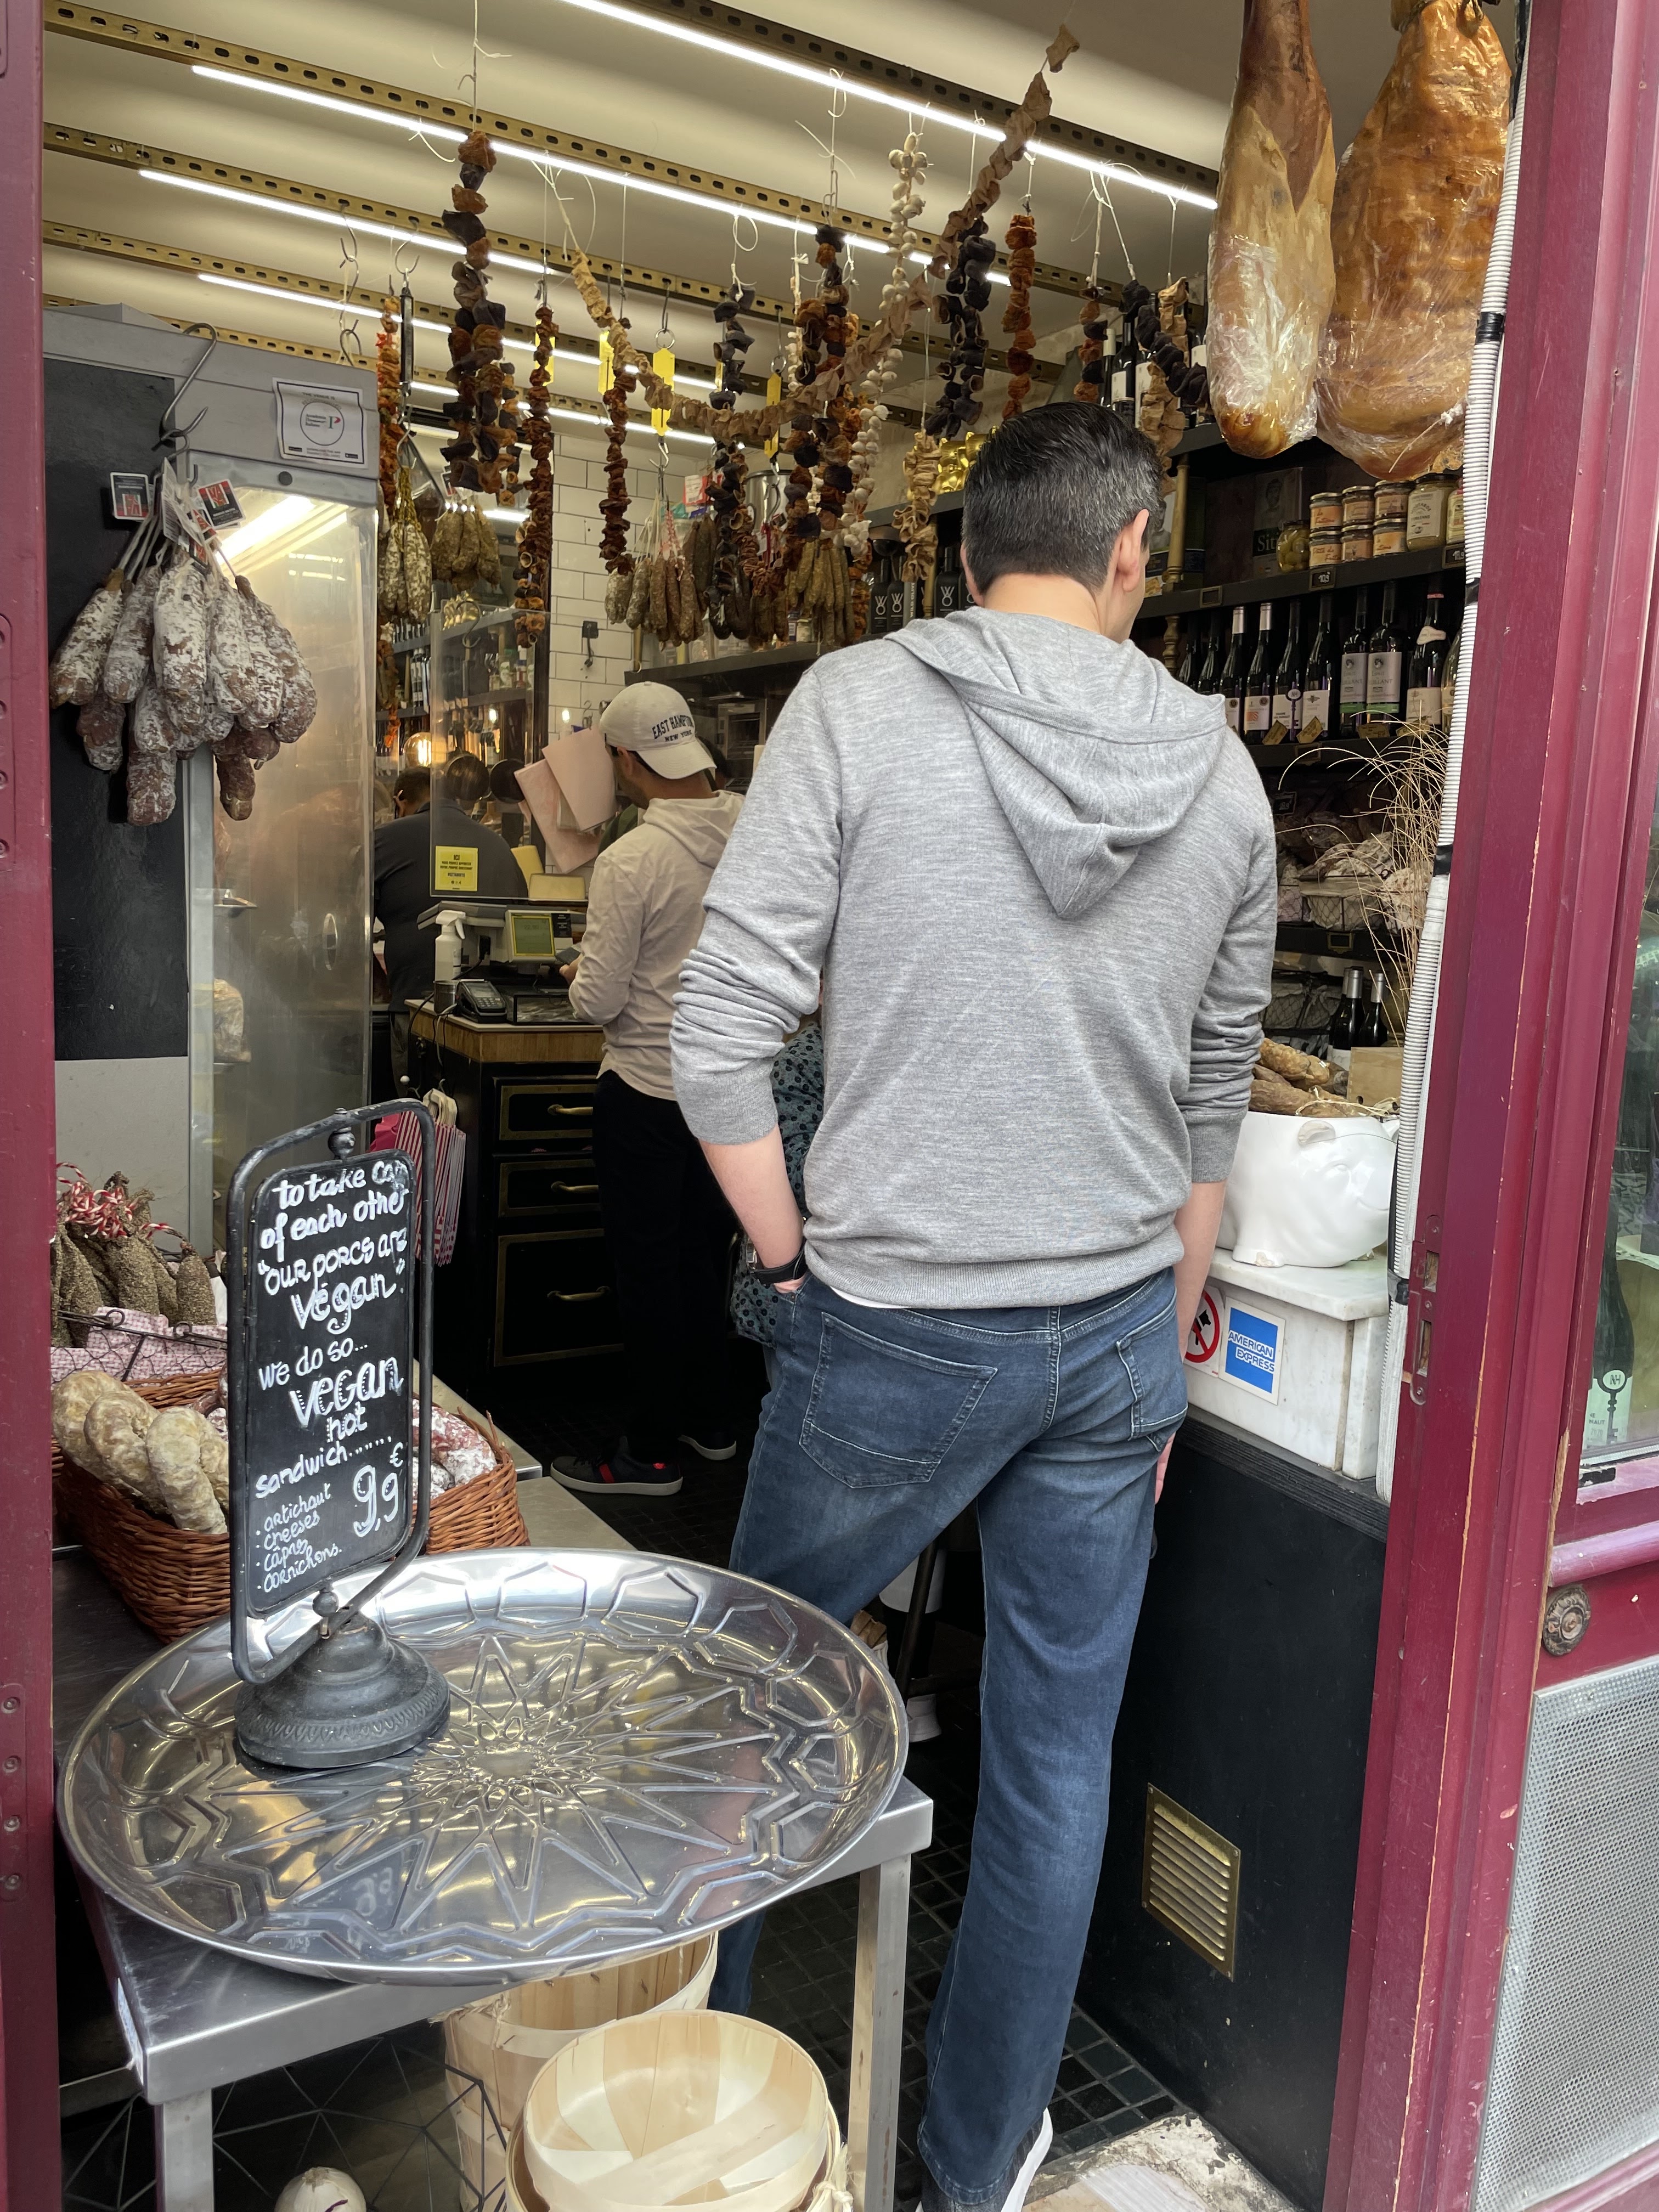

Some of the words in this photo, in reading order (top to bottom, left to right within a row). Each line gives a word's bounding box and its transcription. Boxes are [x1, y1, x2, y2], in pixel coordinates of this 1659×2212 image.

[652, 719, 670, 740] EAST
[664, 733, 679, 742] NEW
[680, 730, 693, 738] YORK
[305, 1168, 366, 1198] take
[260, 1212, 287, 1262] of
[290, 1204, 347, 1241] each
[1228, 1331, 1273, 1358] AMERICAN
[296, 1346, 323, 1376] do
[1236, 1348, 1275, 1373] EXPRESS
[326, 1401, 367, 1443] hot
[353, 1464, 399, 1538] 9,9
